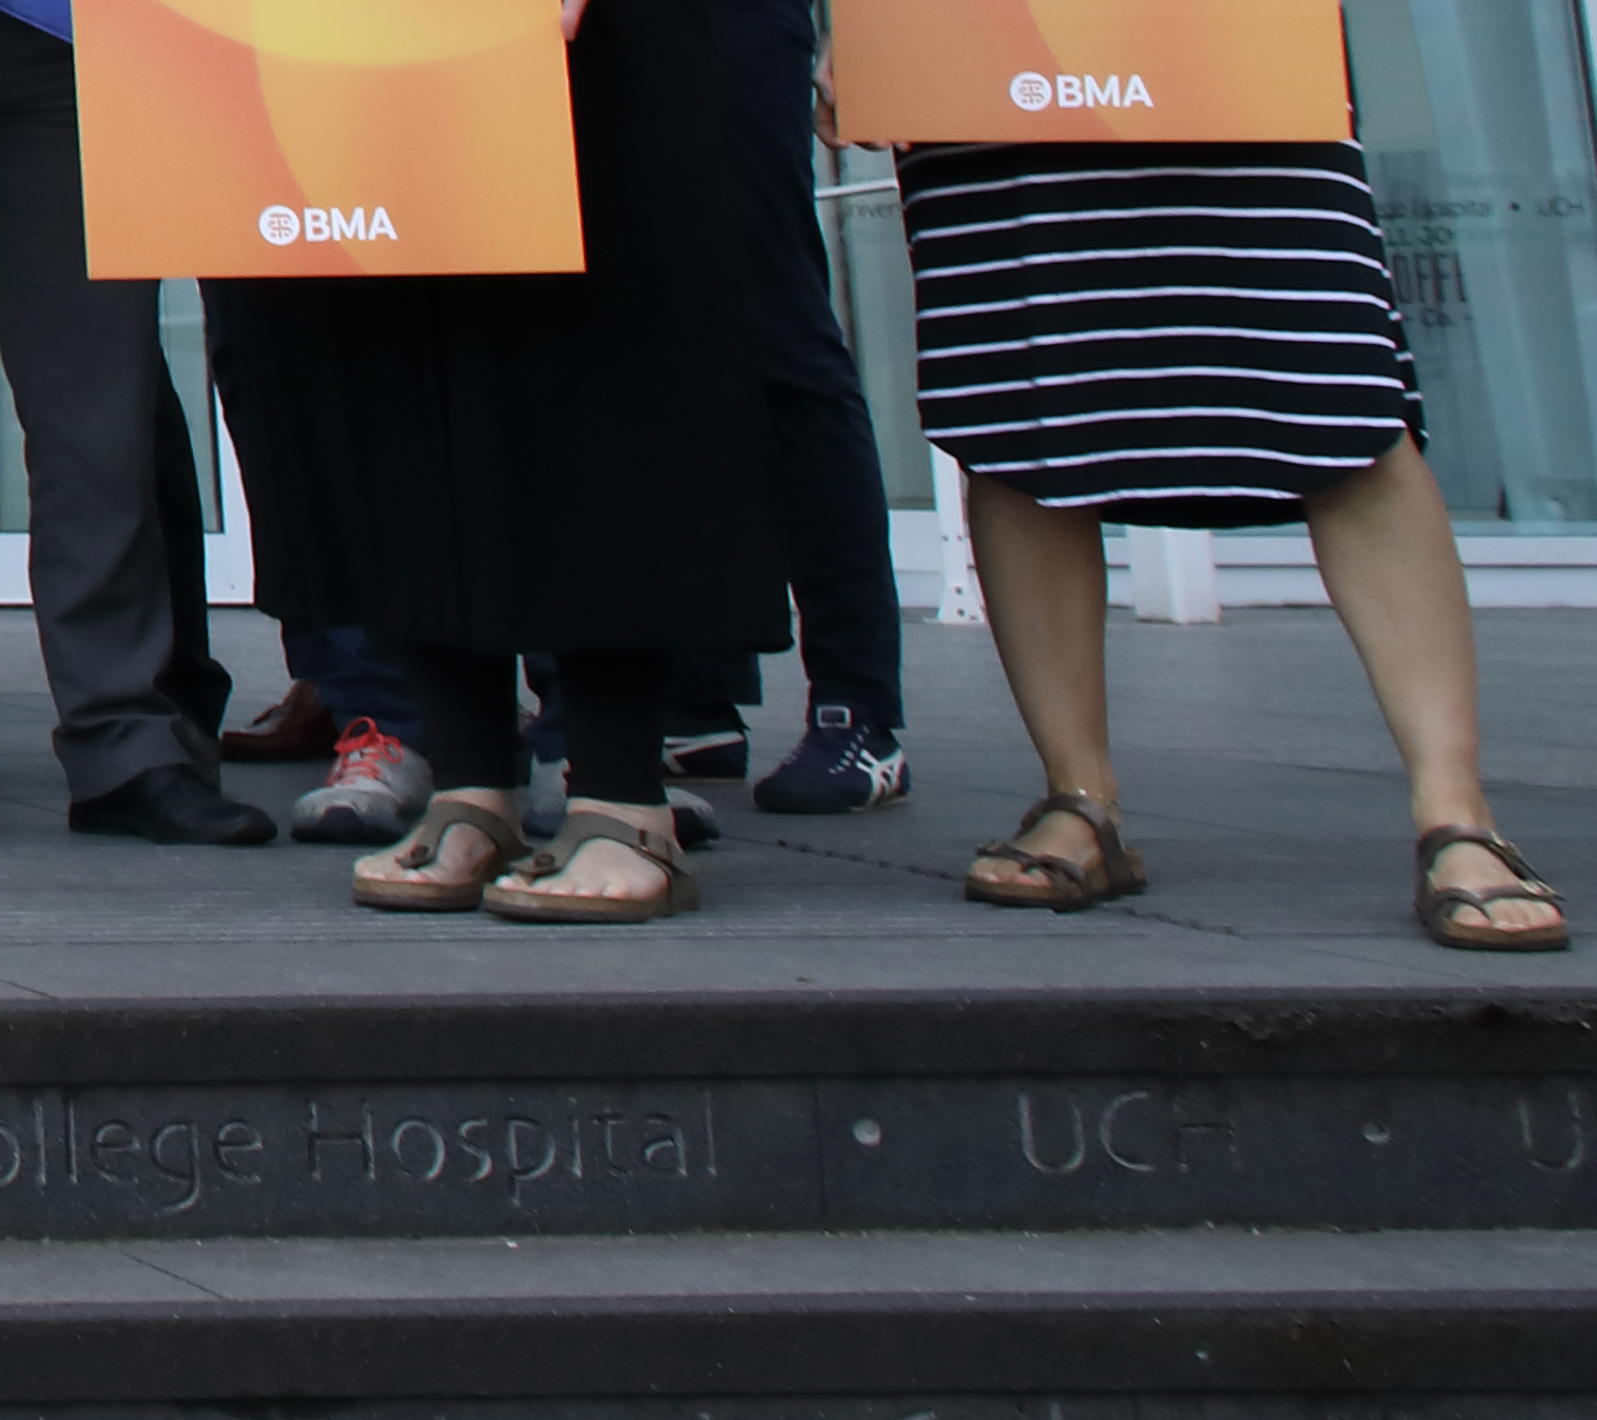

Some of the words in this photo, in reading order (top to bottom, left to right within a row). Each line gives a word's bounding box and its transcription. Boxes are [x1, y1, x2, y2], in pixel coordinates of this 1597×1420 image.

[1055, 73, 1154, 109] BMA
[302, 206, 398, 242] BMA
[307, 1088, 718, 1208] Hospital
[1017, 1089, 1236, 1177] UCH
